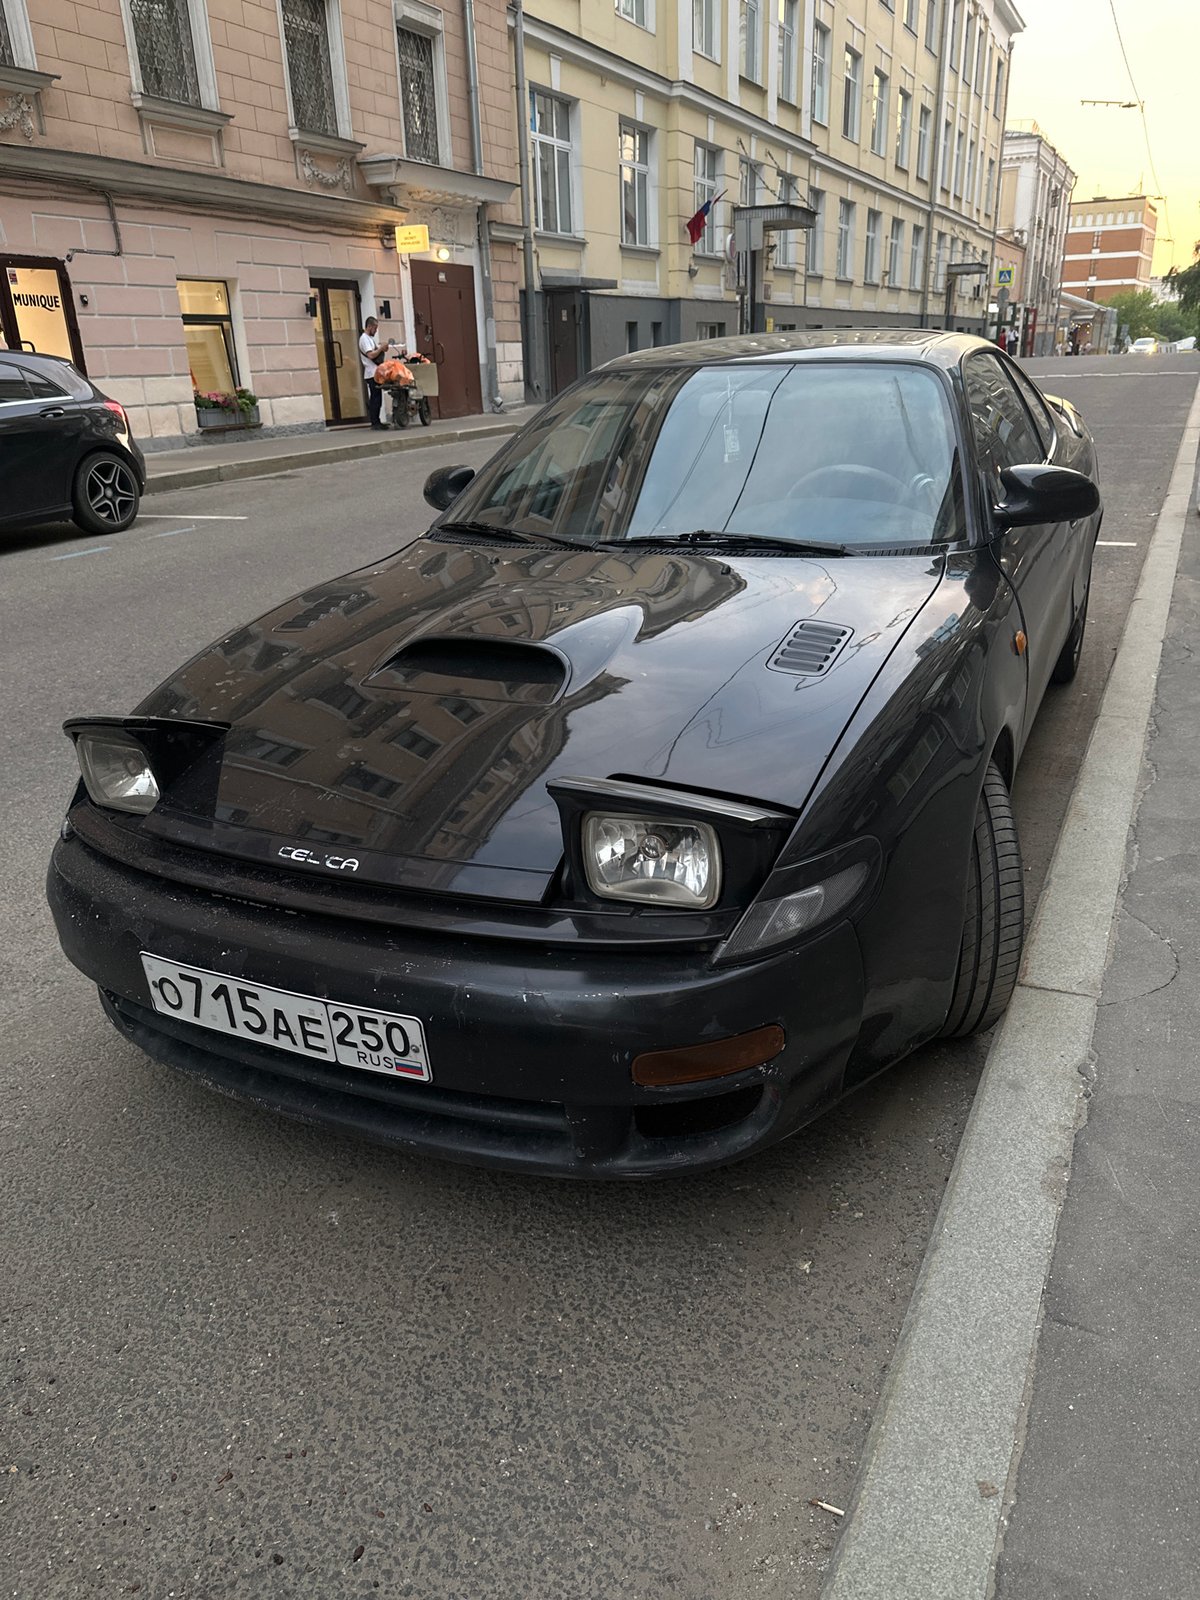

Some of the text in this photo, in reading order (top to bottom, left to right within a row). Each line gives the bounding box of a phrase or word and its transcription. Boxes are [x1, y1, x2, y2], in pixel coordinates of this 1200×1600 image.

[13, 293, 60, 312] MUNIQUE
[332, 1011, 412, 1057] 250
[357, 1050, 394, 1069] RUS
